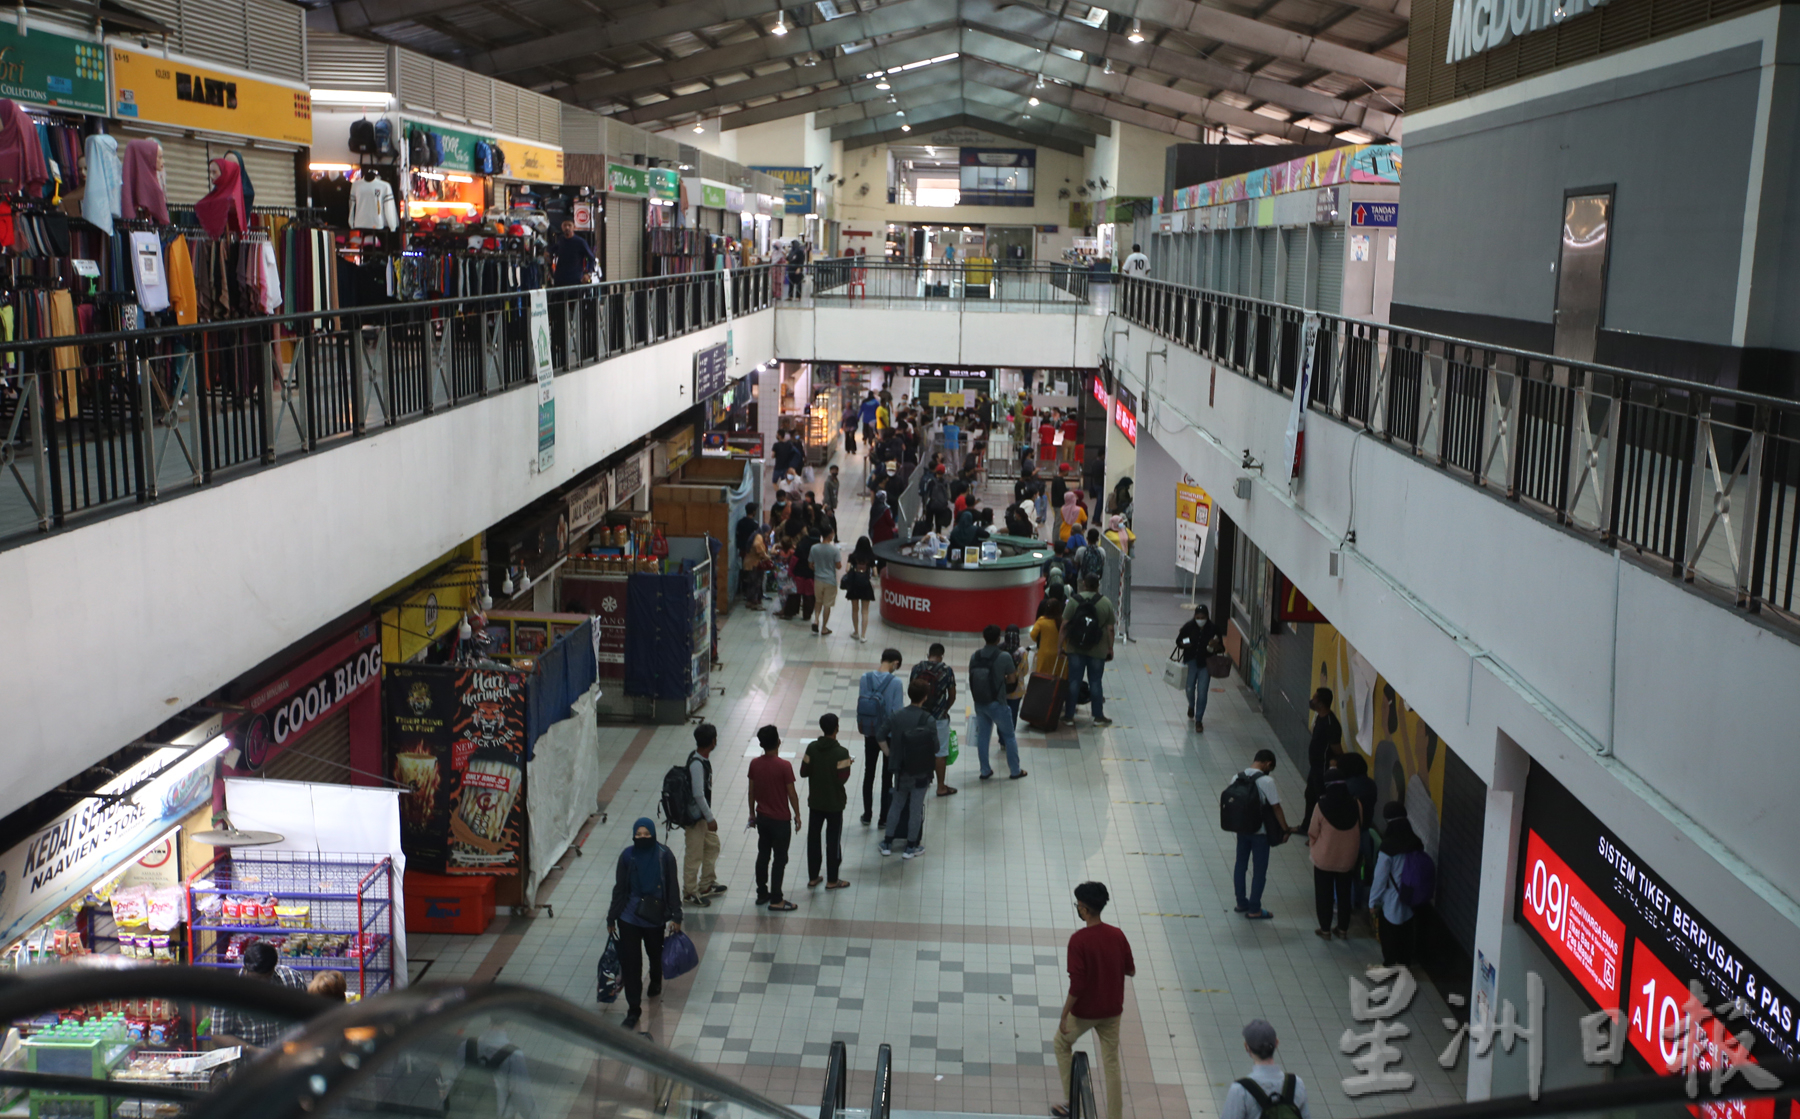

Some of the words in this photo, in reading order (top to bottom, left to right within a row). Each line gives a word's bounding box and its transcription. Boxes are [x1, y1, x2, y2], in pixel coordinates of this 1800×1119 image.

[1, 83, 47, 100] COLLECTIONS
[1371, 206, 1396, 214] TANDAS
[1134, 259, 1145, 270] 10
[884, 589, 931, 613] COUNTER
[472, 672, 506, 692] Hari
[274, 679, 331, 744] COOL
[334, 643, 382, 704] BLOG
[462, 687, 512, 707] Harimau
[395, 716, 420, 724] TIGER
[421, 717, 443, 726] KING
[455, 742, 475, 753] NEW
[463, 729, 490, 748] BLACK
[491, 729, 515, 748] TIGER
[465, 773, 481, 781] ONLY
[23, 814, 78, 879] KEDAI
[30, 835, 99, 893] NAAVIEN
[103, 804, 147, 842] STORE
[1568, 918, 1580, 940] Tiket
[1580, 932, 1590, 951] Bas
[1590, 943, 1595, 957] &
[1598, 836, 1636, 884] SISTEM
[1638, 871, 1671, 917] TIKET
[1672, 906, 1744, 985] BERPUSAT
[1746, 973, 1757, 1001] &
[1760, 986, 1793, 1034] PAS
[1601, 930, 1618, 956] EMAS
[1567, 929, 1577, 948] Pas
[1577, 941, 1593, 967] Masuk
